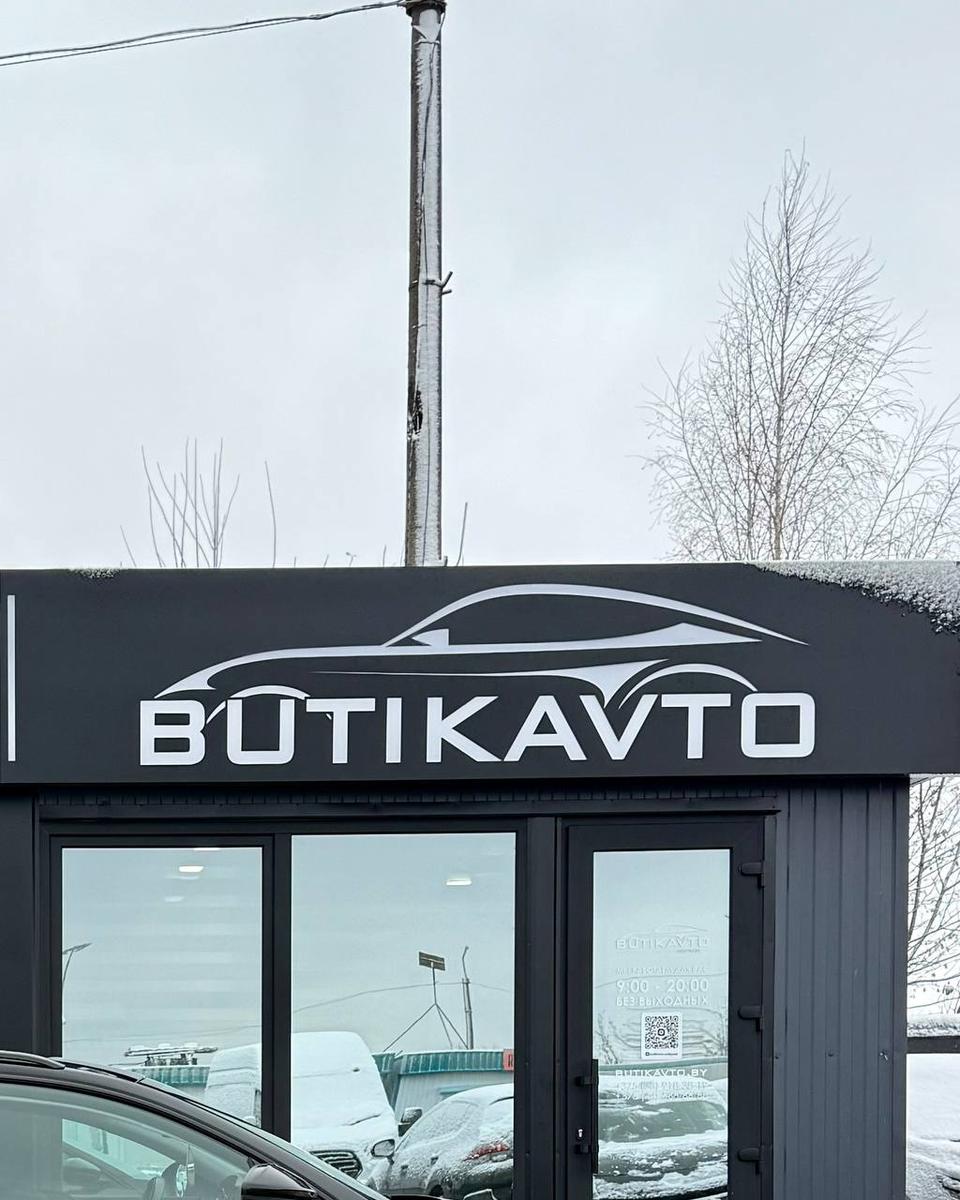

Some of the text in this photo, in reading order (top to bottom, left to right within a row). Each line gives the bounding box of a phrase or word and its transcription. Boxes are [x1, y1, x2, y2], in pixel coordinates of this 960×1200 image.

[140, 692, 816, 766] BUTIKAVTO
[616, 979, 648, 993] 9:00
[666, 978, 709, 993] 20:00
